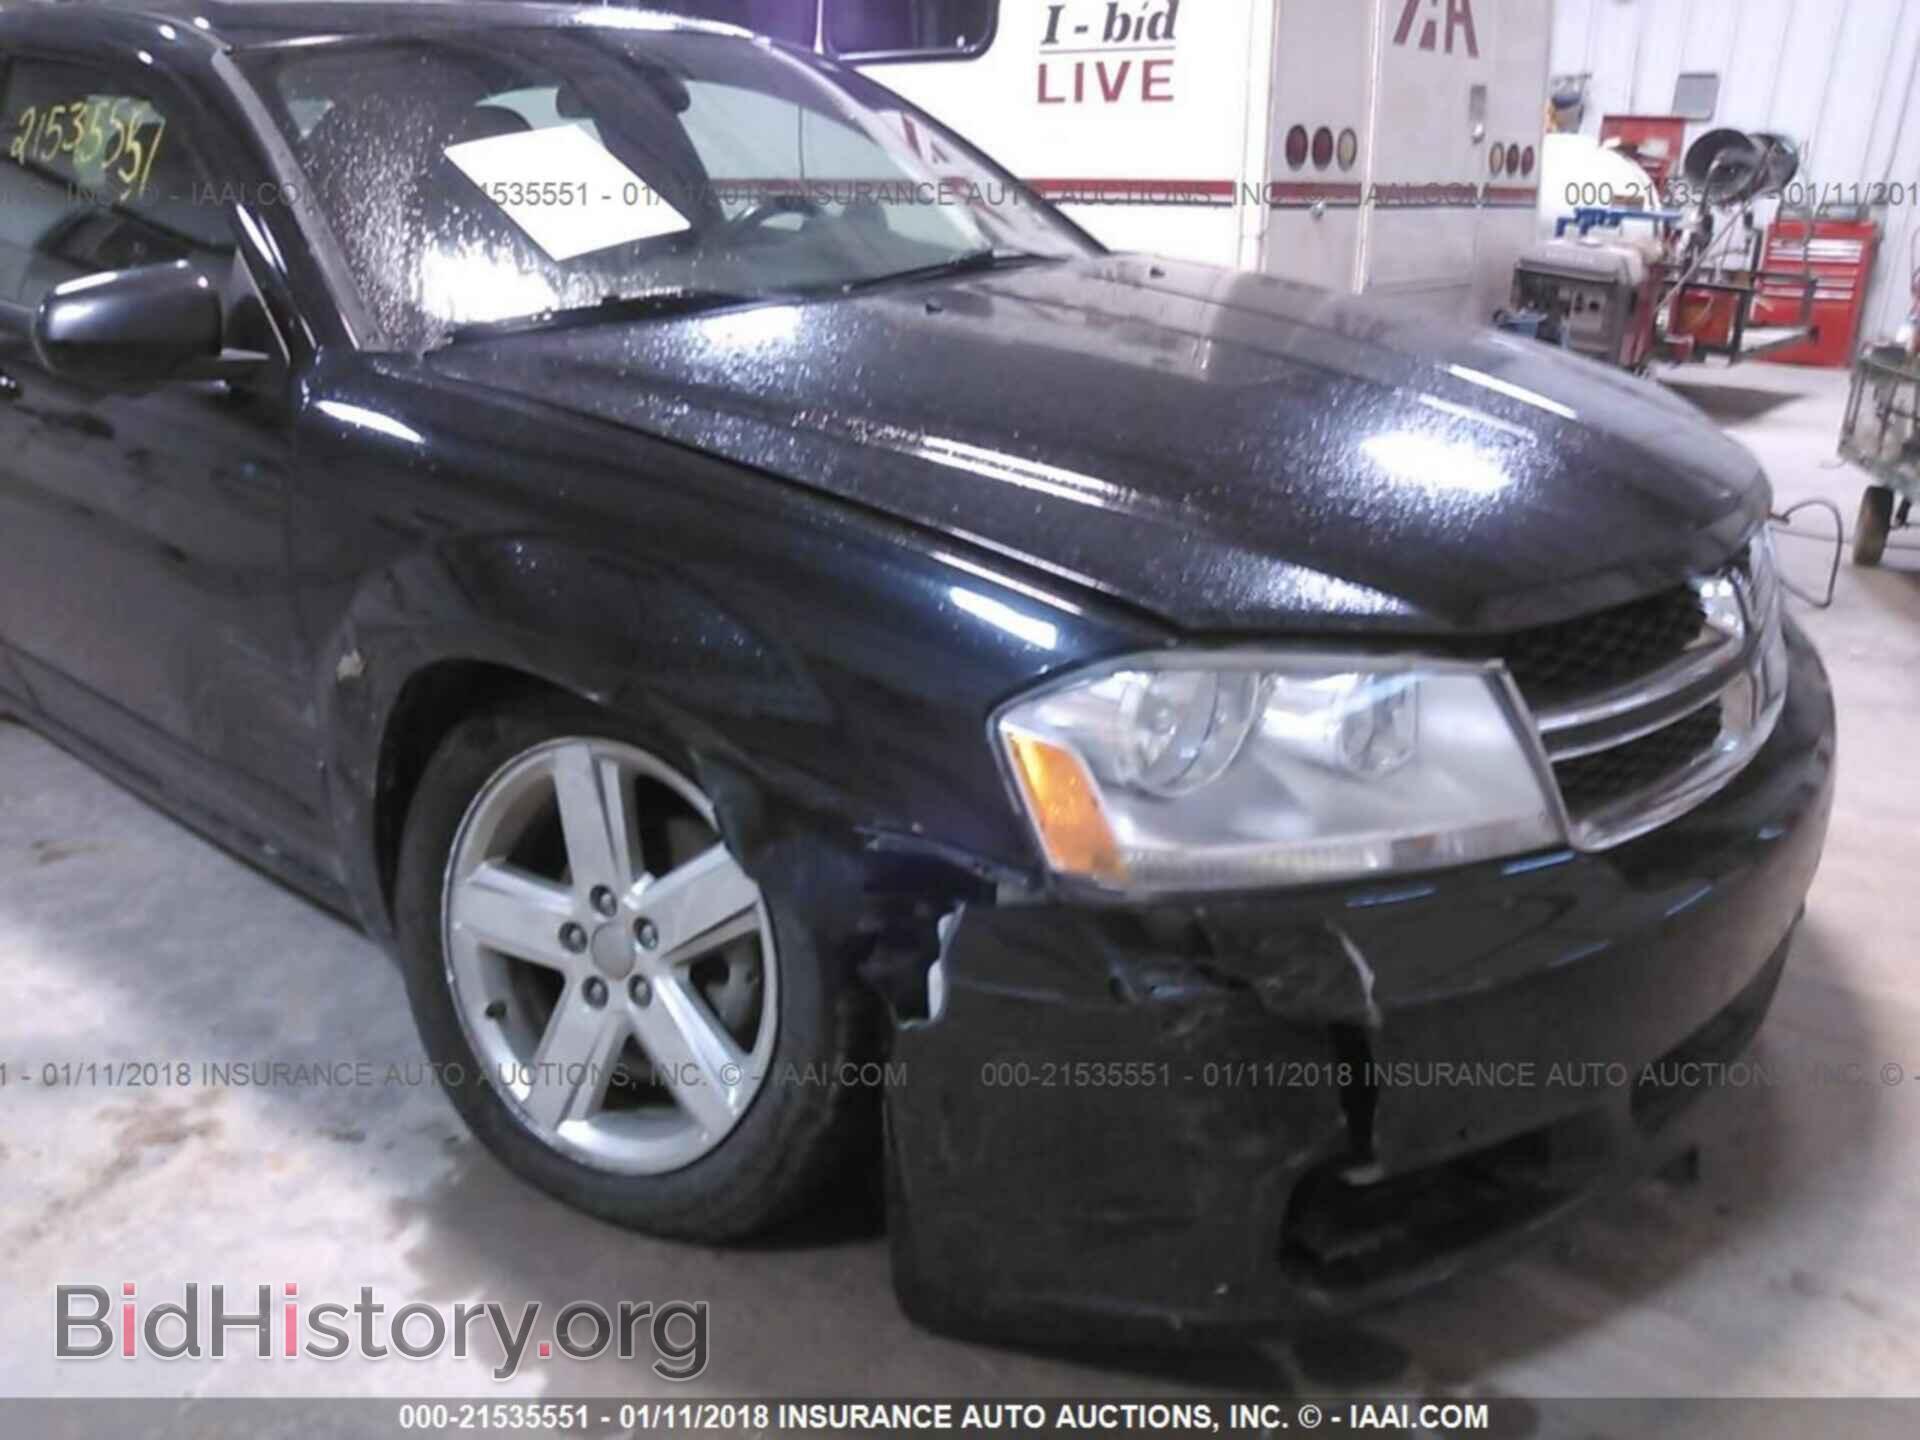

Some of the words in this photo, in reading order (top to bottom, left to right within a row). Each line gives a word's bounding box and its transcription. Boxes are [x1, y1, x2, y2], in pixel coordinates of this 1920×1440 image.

[1040, 4, 1066, 45] I
[1102, 0, 1179, 43] bid
[1037, 59, 1175, 104] LIVE
